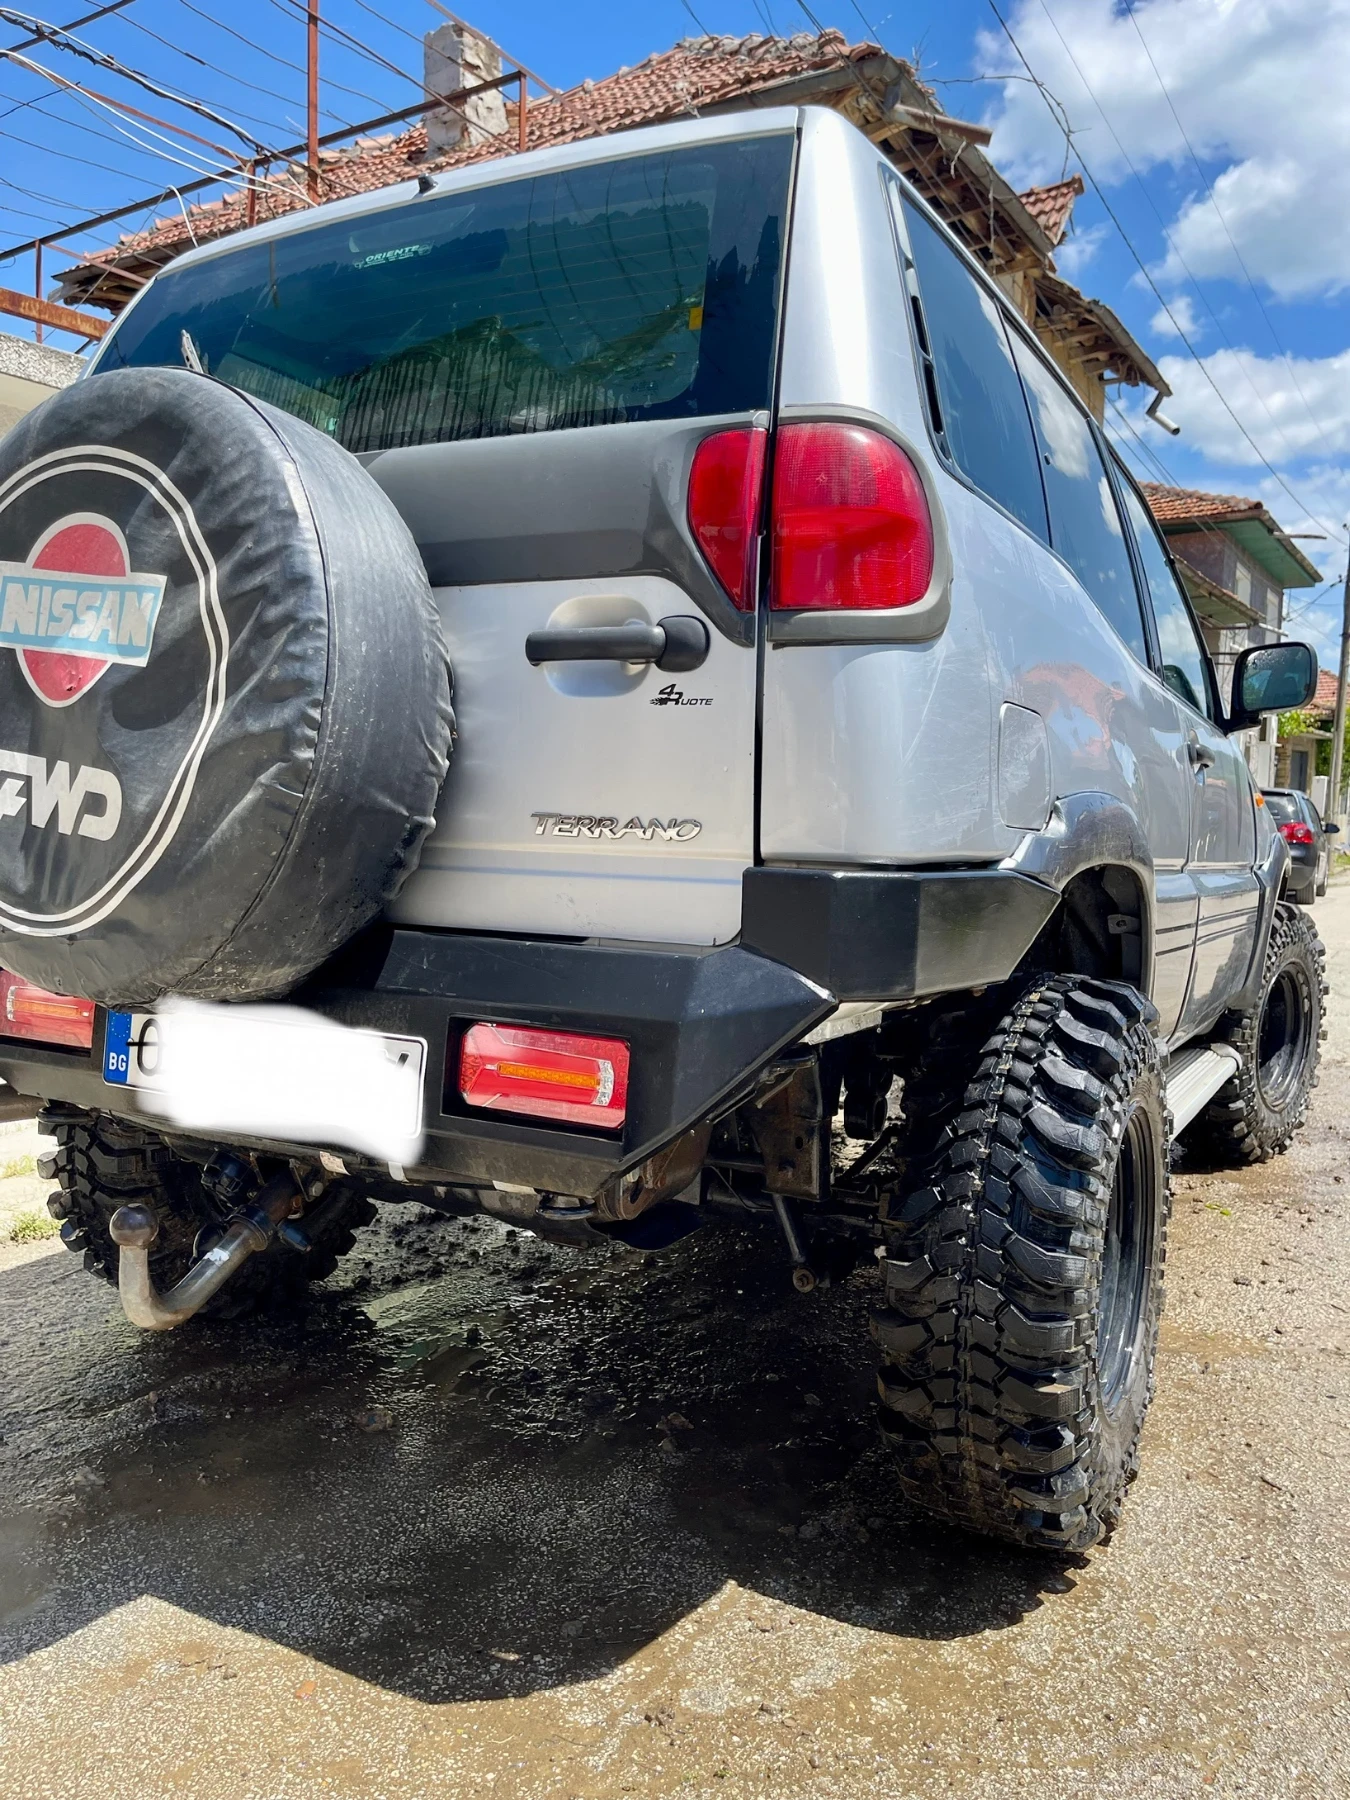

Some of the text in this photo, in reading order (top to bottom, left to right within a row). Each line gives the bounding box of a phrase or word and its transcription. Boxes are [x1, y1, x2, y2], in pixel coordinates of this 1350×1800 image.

[365, 244, 420, 263] ORIENTE
[0, 582, 155, 647] NISSAN
[530, 811, 702, 842] TERRANO
[108, 1051, 127, 1072] BG
